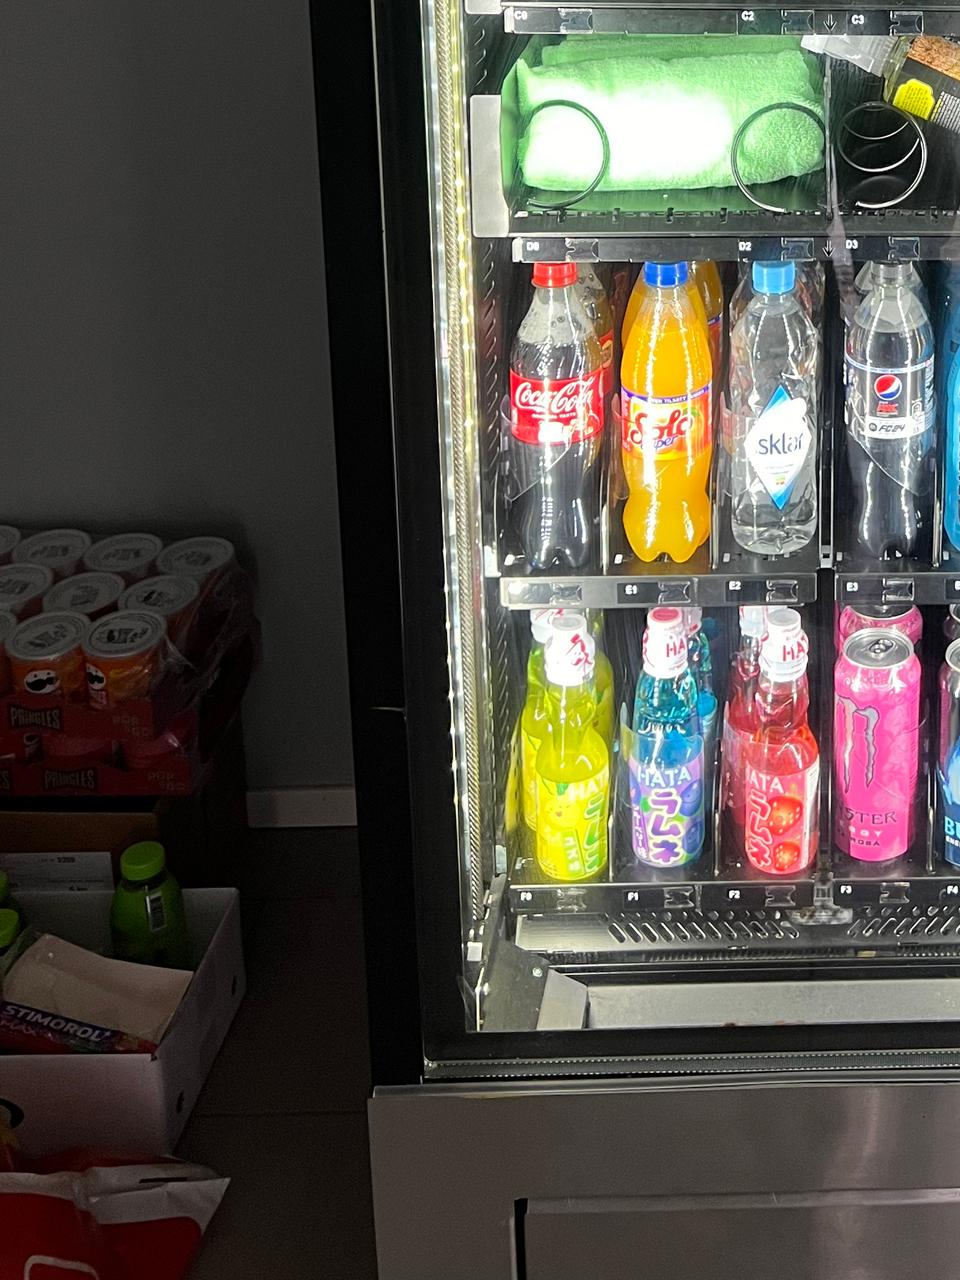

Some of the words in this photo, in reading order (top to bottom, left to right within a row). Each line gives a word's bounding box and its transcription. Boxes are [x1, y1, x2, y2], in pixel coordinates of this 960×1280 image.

[514, 10, 528, 21] C0
[741, 10, 755, 21] C2
[851, 14, 865, 25] C3
[526, 240, 540, 251] D0
[738, 240, 752, 251] D2
[845, 239, 858, 250] D3
[624, 585, 638, 595] E1
[729, 580, 742, 591] E2
[846, 582, 858, 592] E3
[9, 706, 62, 730] PRINGLES
[44, 768, 96, 791] PRINGLES
[636, 763, 692, 787] HATA
[748, 771, 785, 794] ATA
[648, 788, 683, 866] ラムネ
[748, 788, 774, 867] ラムネ
[520, 891, 532, 901] F0
[627, 891, 639, 901] F1
[728, 889, 740, 899] F2
[840, 885, 851, 894] F3
[947, 885, 958, 894] F4
[2, 1004, 107, 1042] STIMOROL
